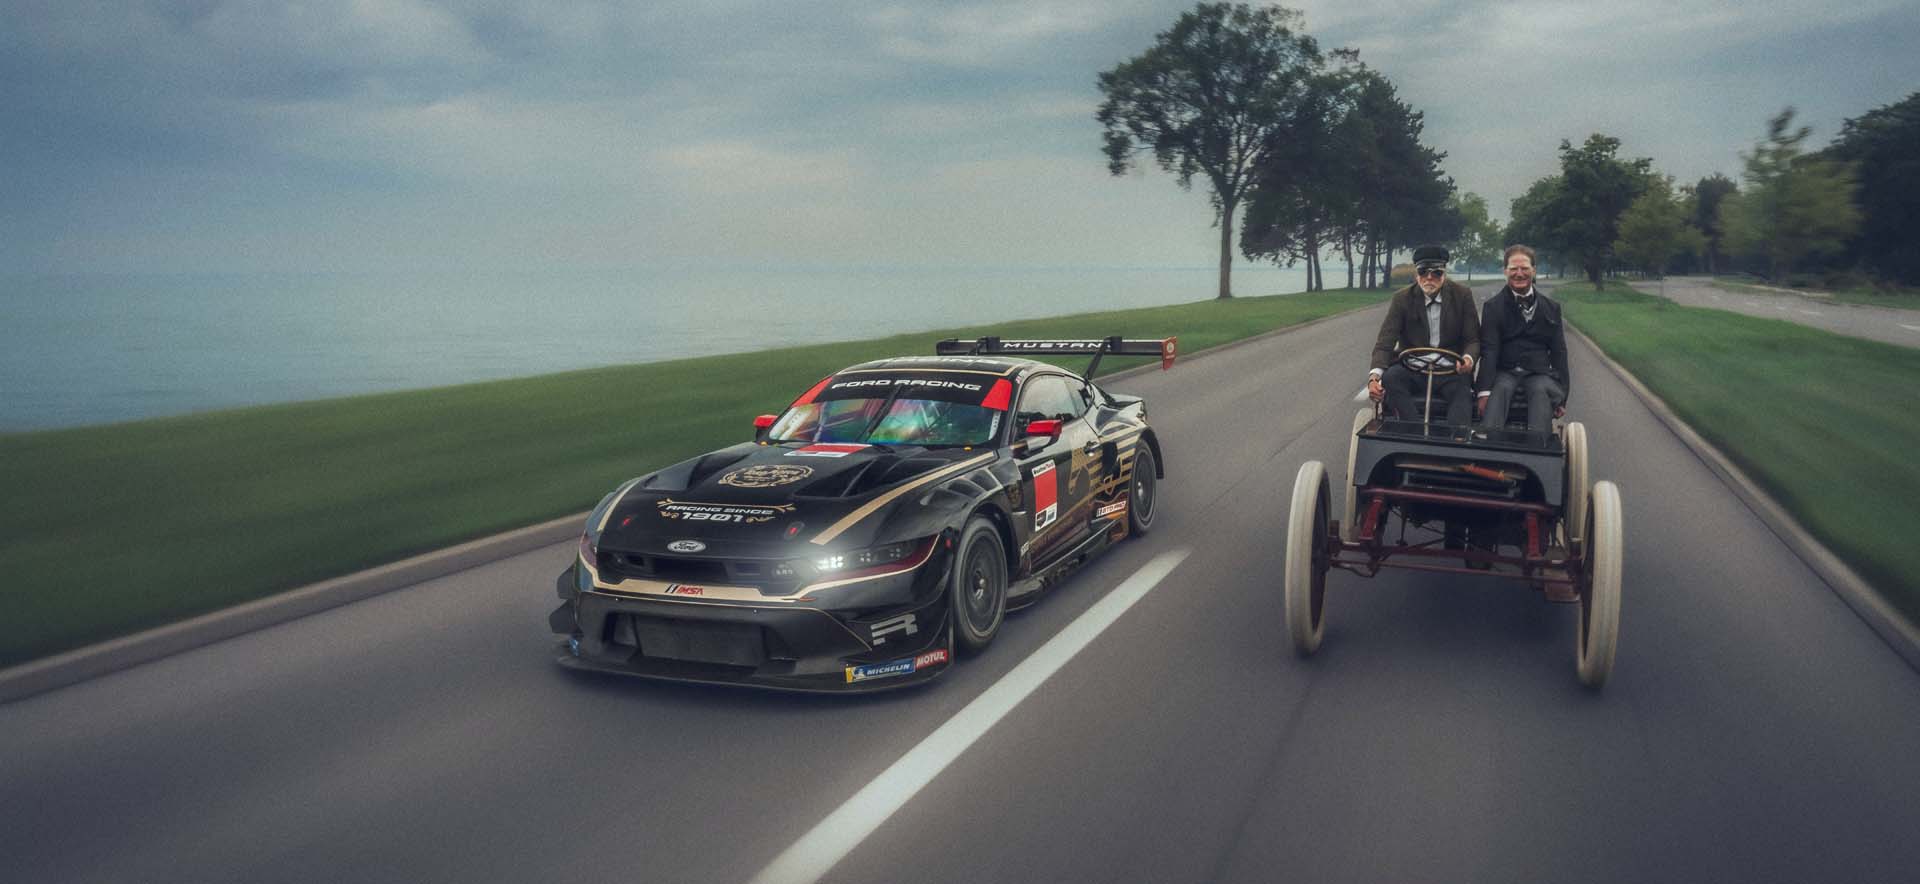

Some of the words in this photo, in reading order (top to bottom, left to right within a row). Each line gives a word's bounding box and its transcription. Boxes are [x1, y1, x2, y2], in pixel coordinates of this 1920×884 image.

[832, 379, 888, 389] FORD
[894, 379, 982, 391] RACING
[682, 512, 743, 522] 1901
[916, 652, 945, 666] MOTUL
[867, 664, 910, 675] MICHELIN
